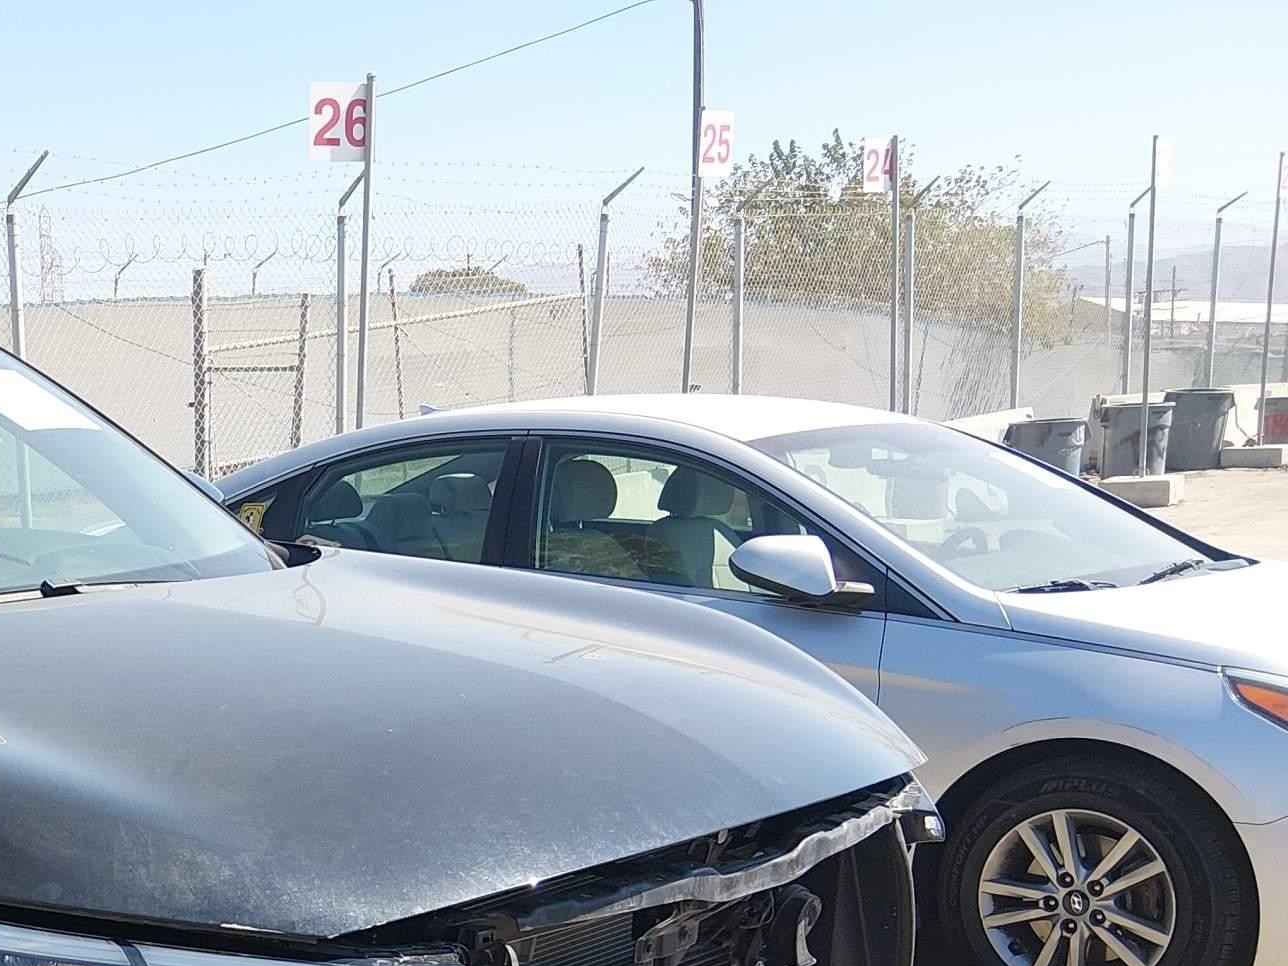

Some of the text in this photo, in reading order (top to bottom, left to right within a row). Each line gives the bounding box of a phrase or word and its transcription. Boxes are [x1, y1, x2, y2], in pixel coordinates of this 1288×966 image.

[313, 98, 367, 147] 26
[702, 124, 730, 163] 25
[865, 148, 894, 182] 24
